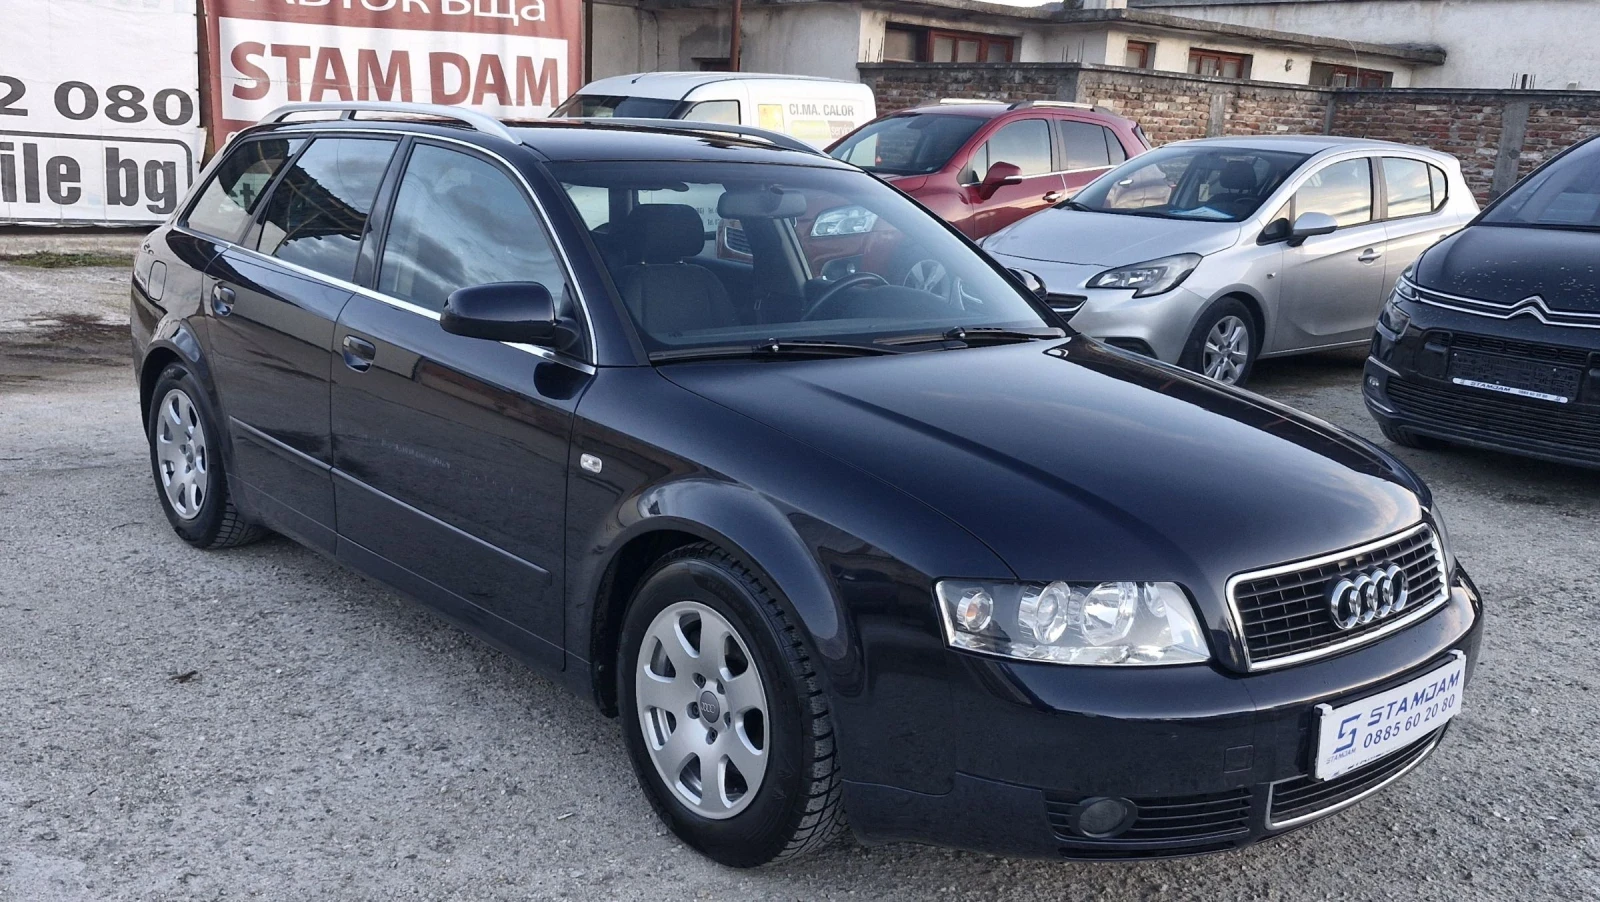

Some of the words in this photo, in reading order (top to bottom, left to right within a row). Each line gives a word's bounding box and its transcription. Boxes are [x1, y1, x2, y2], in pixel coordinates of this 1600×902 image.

[230, 41, 411, 104] STAM
[430, 51, 559, 108] DAM
[54, 80, 194, 126] 080
[823, 104, 854, 117] CALOR
[1363, 722, 1401, 748] 0885
[1405, 712, 1420, 731] 60
[1424, 704, 1439, 722] 20
[1441, 694, 1455, 713] 80
[1367, 670, 1461, 726] STAMJAM
